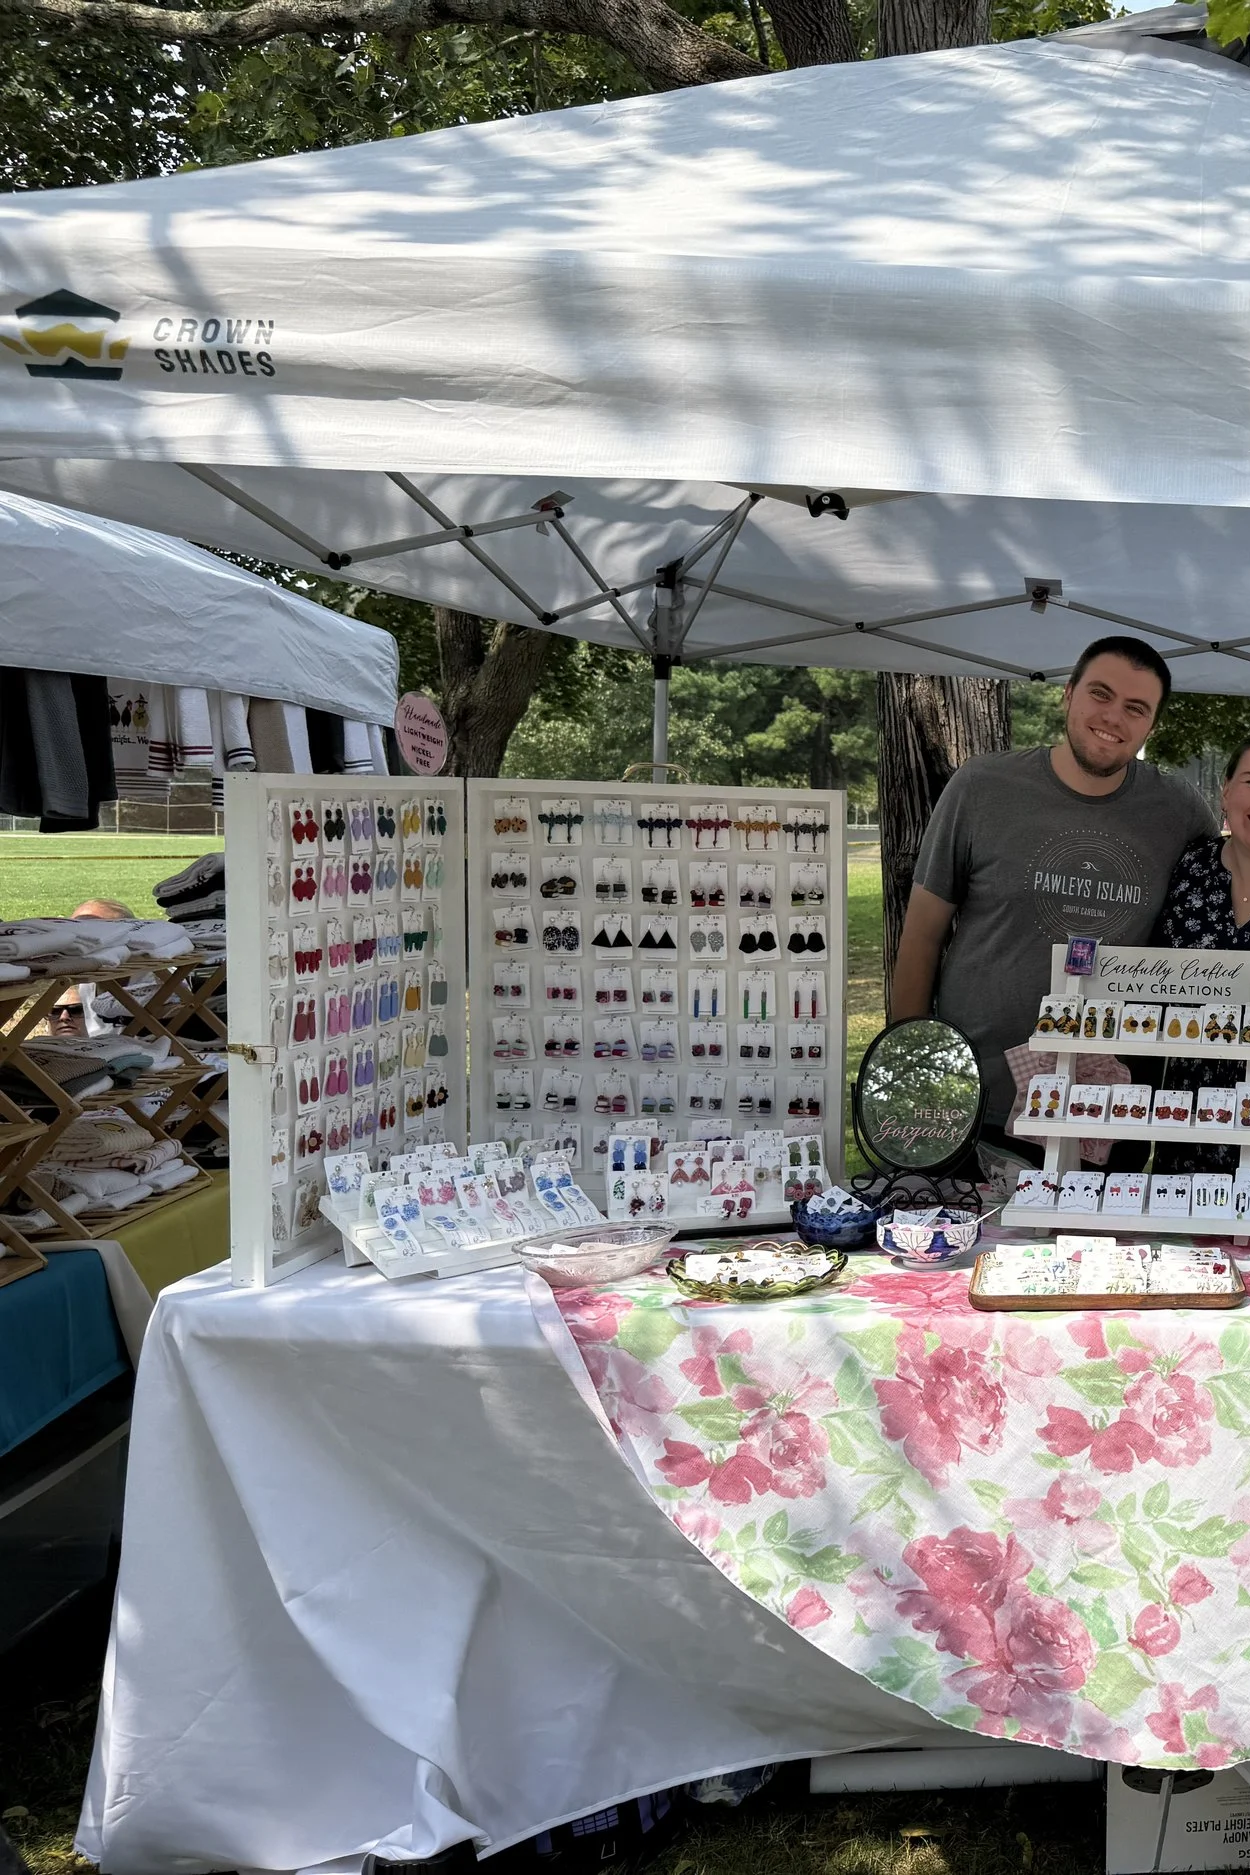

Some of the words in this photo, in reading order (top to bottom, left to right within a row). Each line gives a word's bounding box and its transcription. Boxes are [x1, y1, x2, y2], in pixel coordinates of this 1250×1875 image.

[153, 317, 275, 345] CROWN
[155, 348, 276, 377] SHADES
[403, 725, 443, 747] LIGHTWEIGHT
[416, 757, 431, 769] FREE
[1034, 871, 1093, 899] PAWLEYS
[1096, 880, 1141, 905] ISLAND
[1100, 955, 1176, 984] Carefully
[1180, 958, 1244, 981] Crafted
[1107, 981, 1145, 993] CLAY
[1150, 984, 1232, 997] CREATIONS
[914, 1108, 960, 1119] HELLO
[872, 1109, 974, 1149] Gorgeous!
[1186, 1820, 1221, 1833] PLATES
